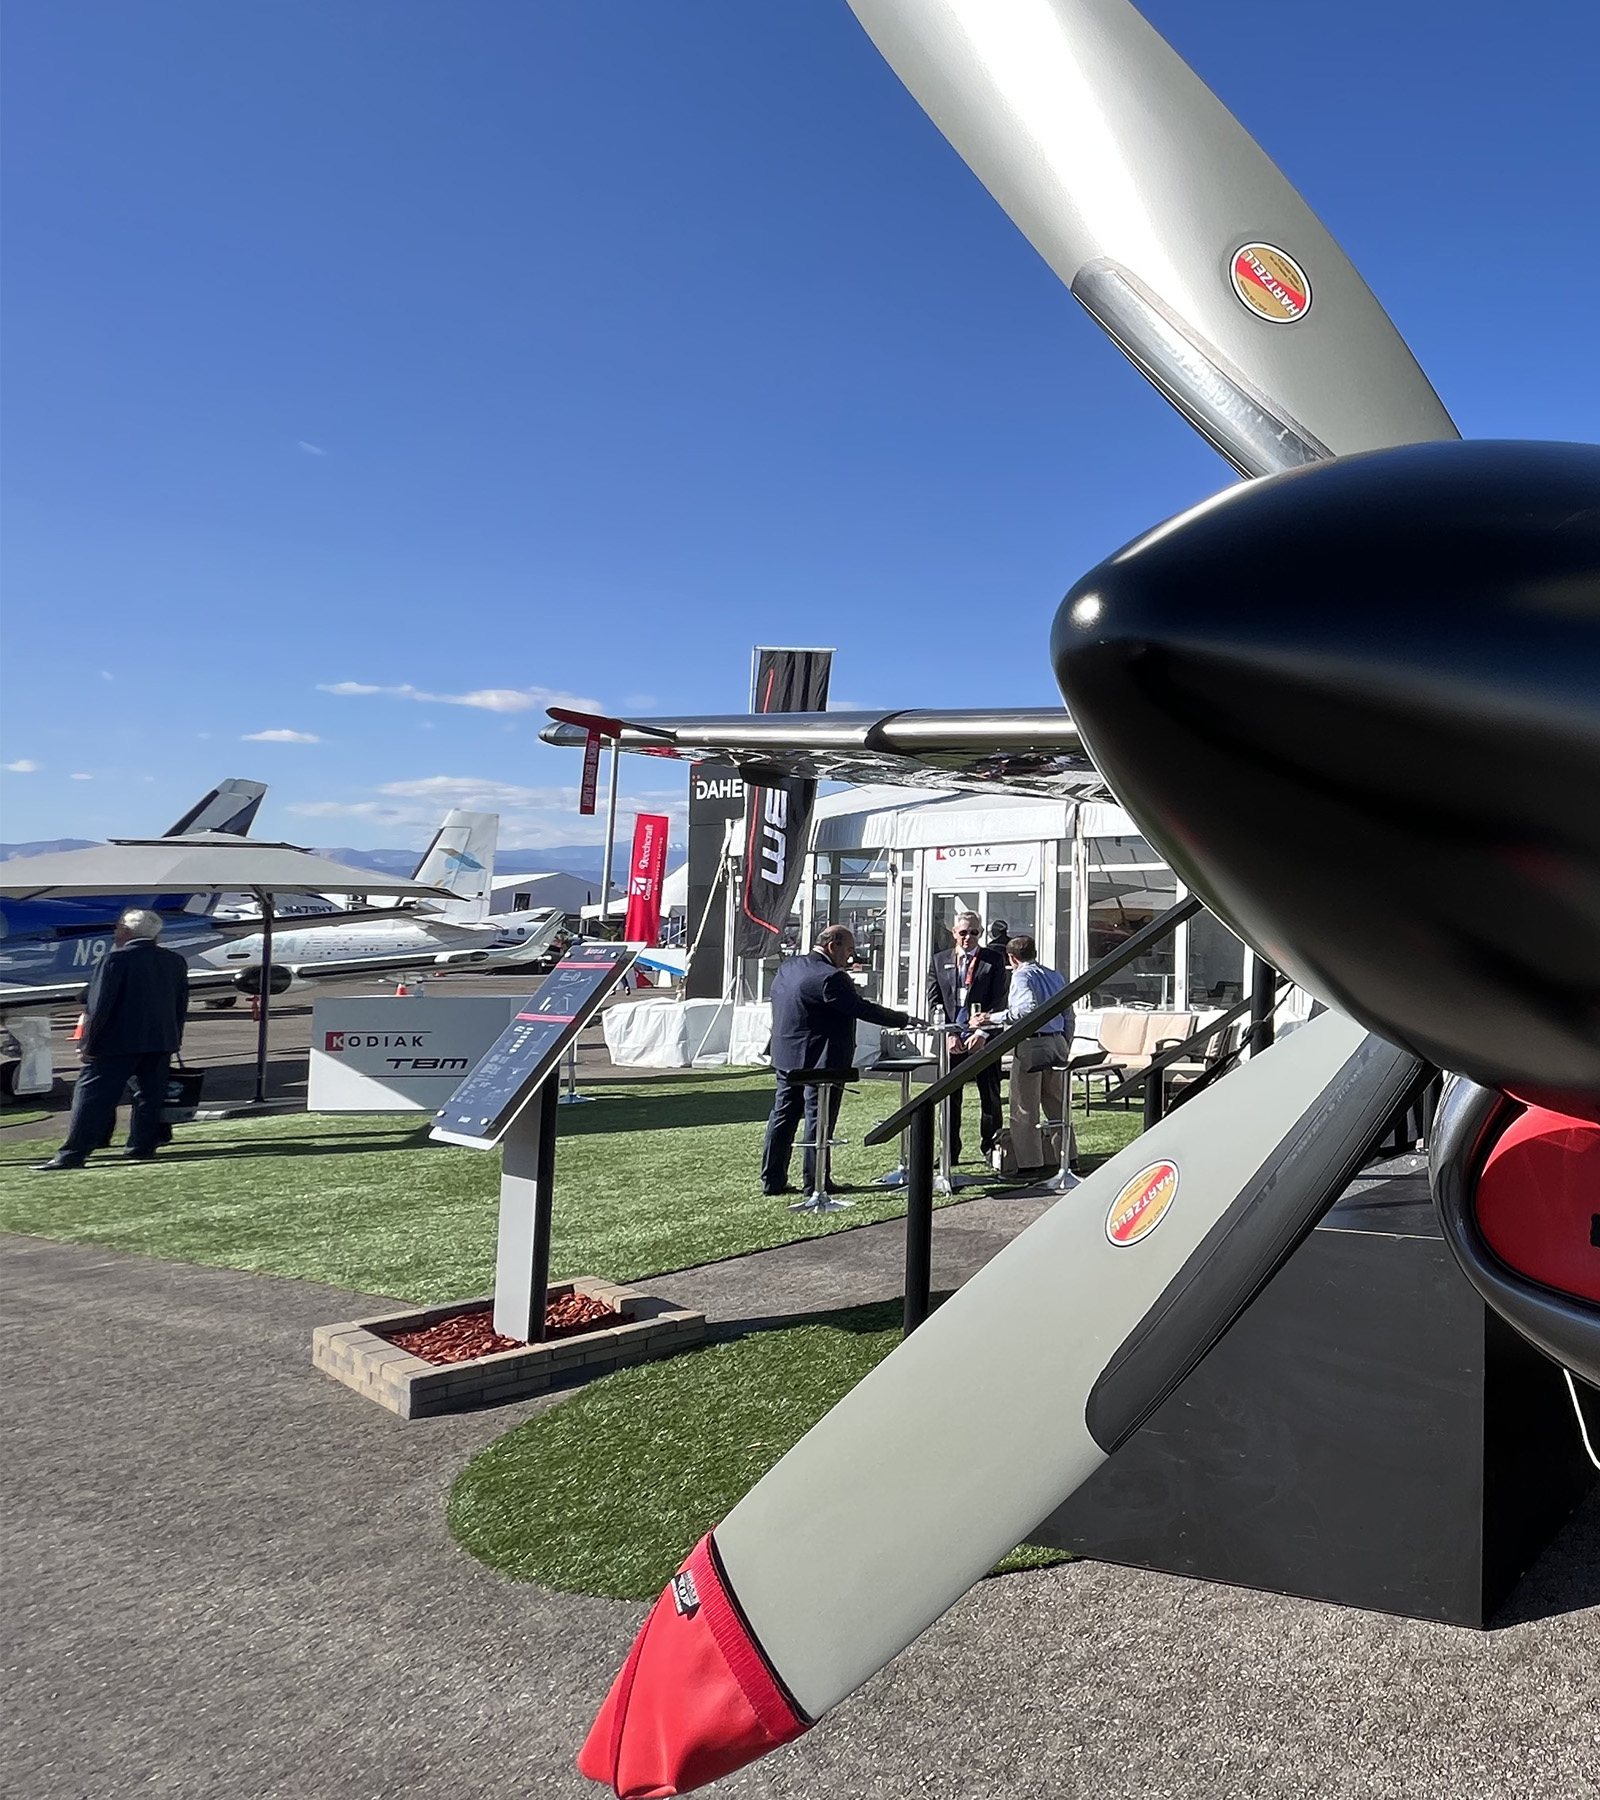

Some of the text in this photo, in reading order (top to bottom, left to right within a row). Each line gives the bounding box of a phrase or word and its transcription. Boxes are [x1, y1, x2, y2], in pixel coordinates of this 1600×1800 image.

[1244, 250, 1300, 316] HARTZELL
[696, 779, 743, 800] DAHE
[939, 847, 991, 859] KODIAK
[970, 863, 1018, 873] TBM
[72, 939, 110, 966] N9
[332, 1035, 424, 1048] KODIAK
[386, 1058, 469, 1070] TBM
[1111, 1171, 1174, 1231] HARTZELL
